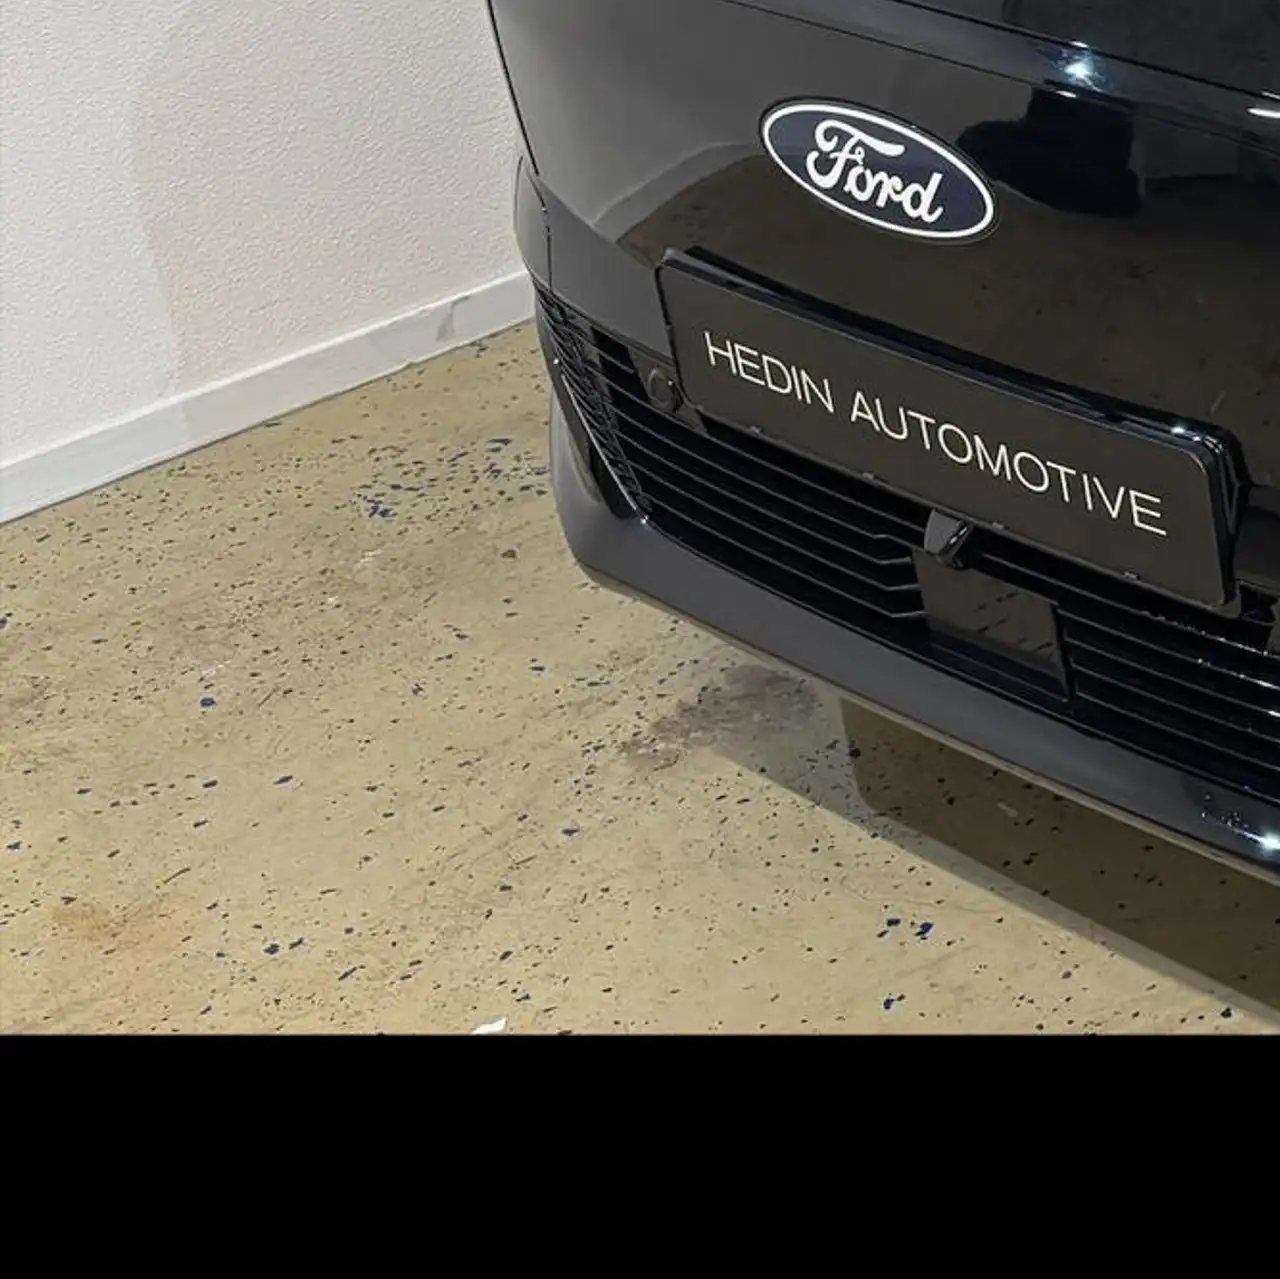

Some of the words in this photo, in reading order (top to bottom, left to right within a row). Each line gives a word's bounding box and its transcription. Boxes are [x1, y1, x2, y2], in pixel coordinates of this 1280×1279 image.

[804, 119, 945, 224] Ford
[703, 331, 835, 414] HEDIN
[849, 390, 1168, 537] AUTOMOTIVE
